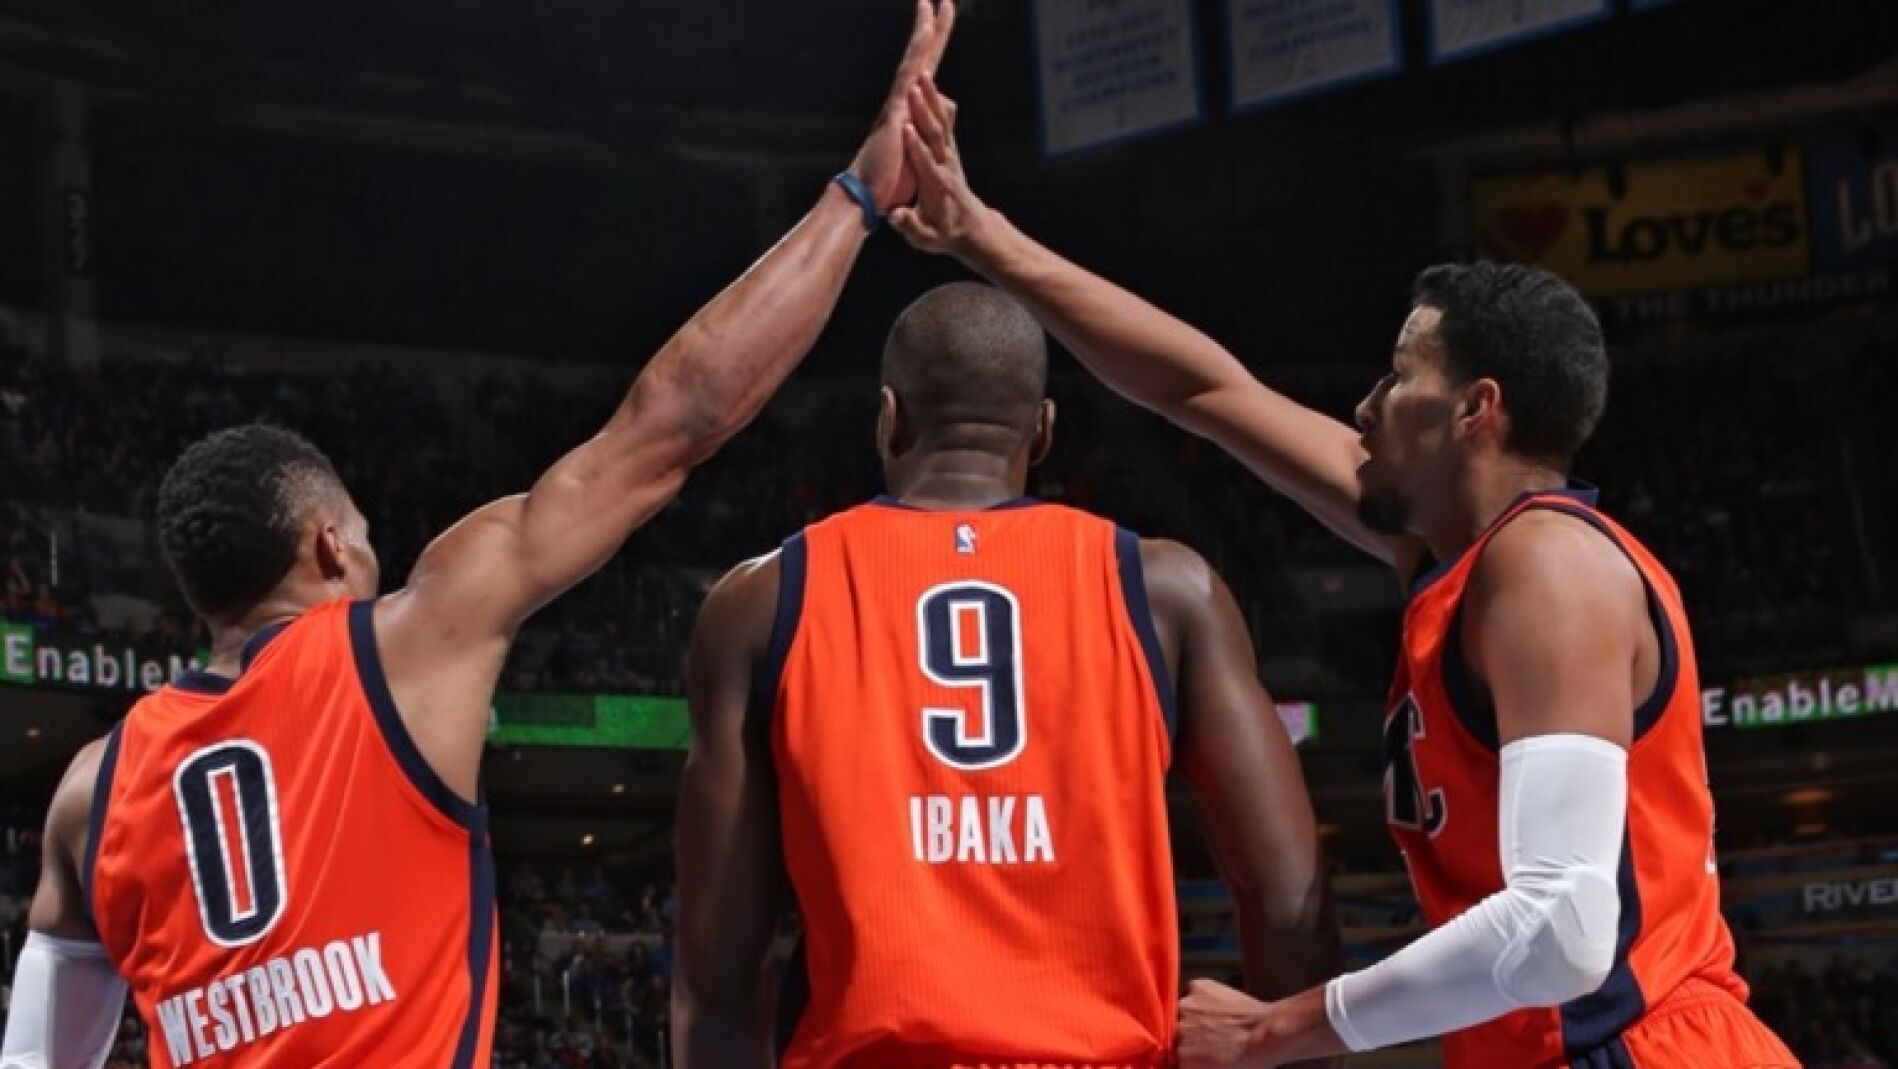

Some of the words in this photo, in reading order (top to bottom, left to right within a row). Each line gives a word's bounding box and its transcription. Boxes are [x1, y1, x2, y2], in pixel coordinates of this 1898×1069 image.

[917, 579, 1027, 771] 9
[173, 737, 288, 949] 0
[909, 795, 1055, 865] IBAKA
[156, 932, 396, 1068] WESTBROOK
